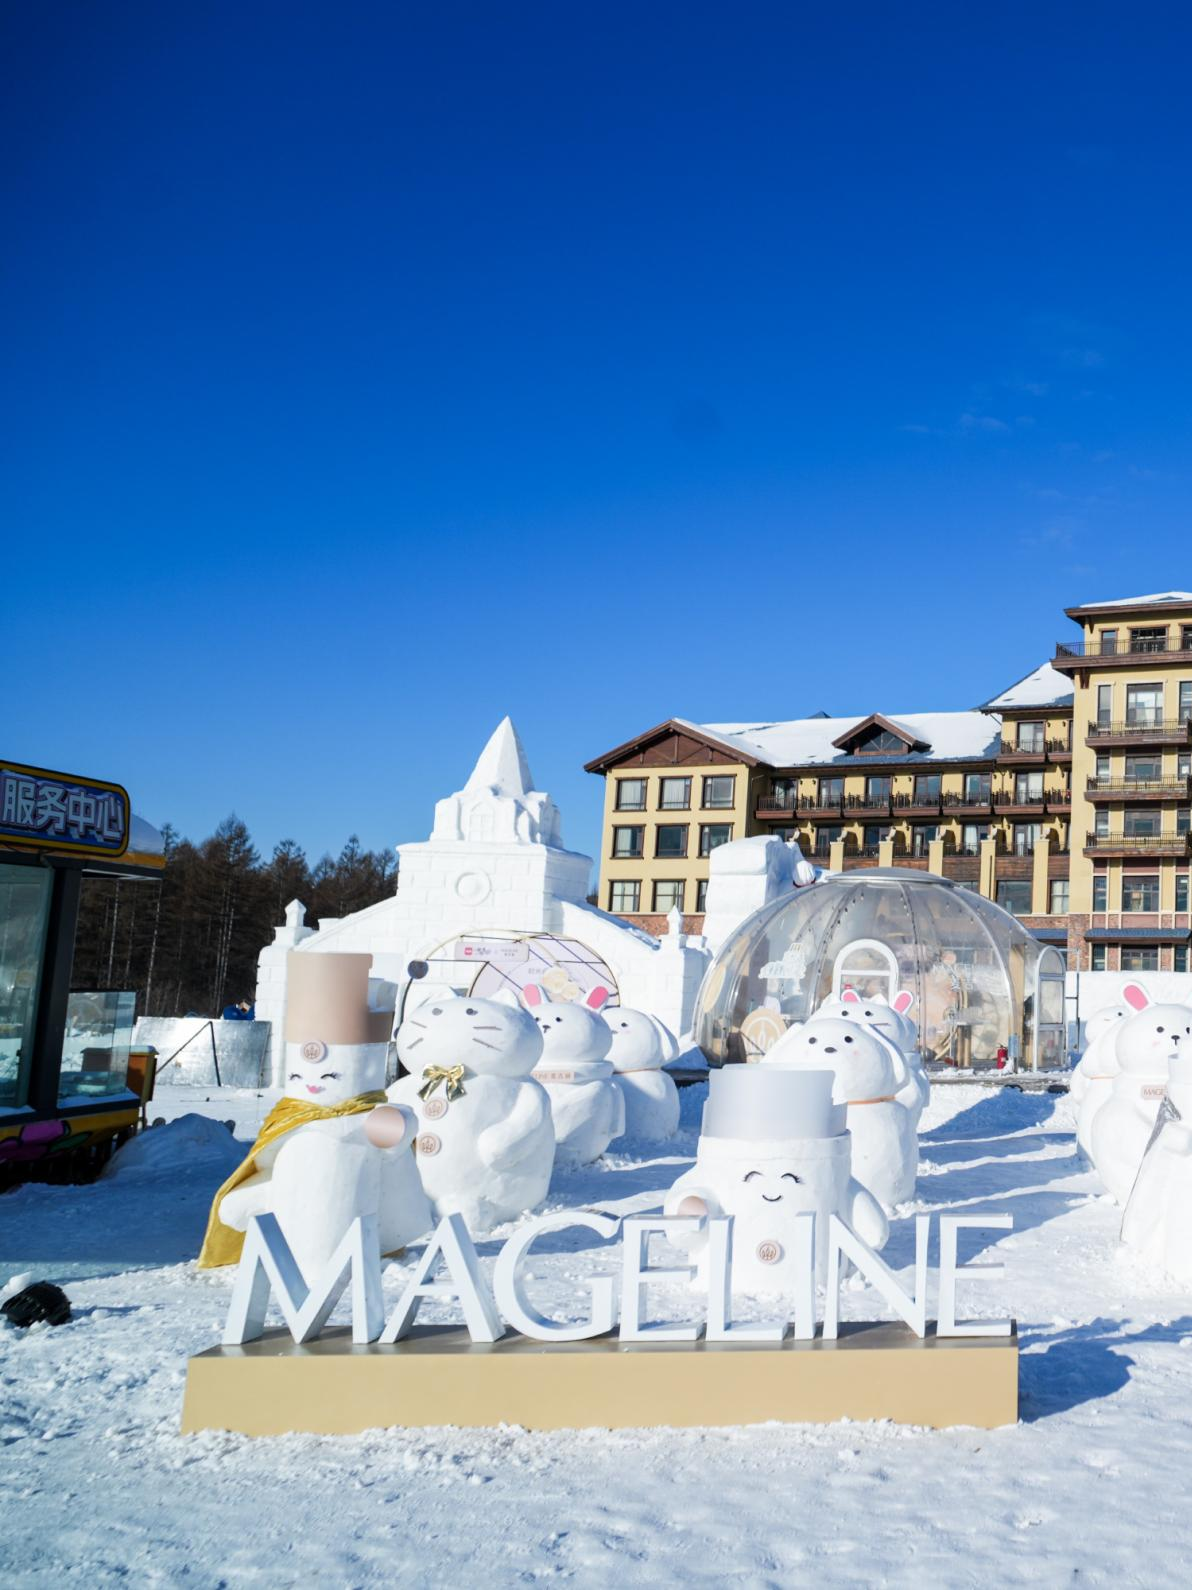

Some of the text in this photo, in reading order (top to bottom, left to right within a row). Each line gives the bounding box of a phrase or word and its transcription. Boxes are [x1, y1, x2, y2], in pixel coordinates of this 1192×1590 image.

[2, 777, 124, 839] 服务中心
[221, 1210, 1014, 1346] MAGELINE
